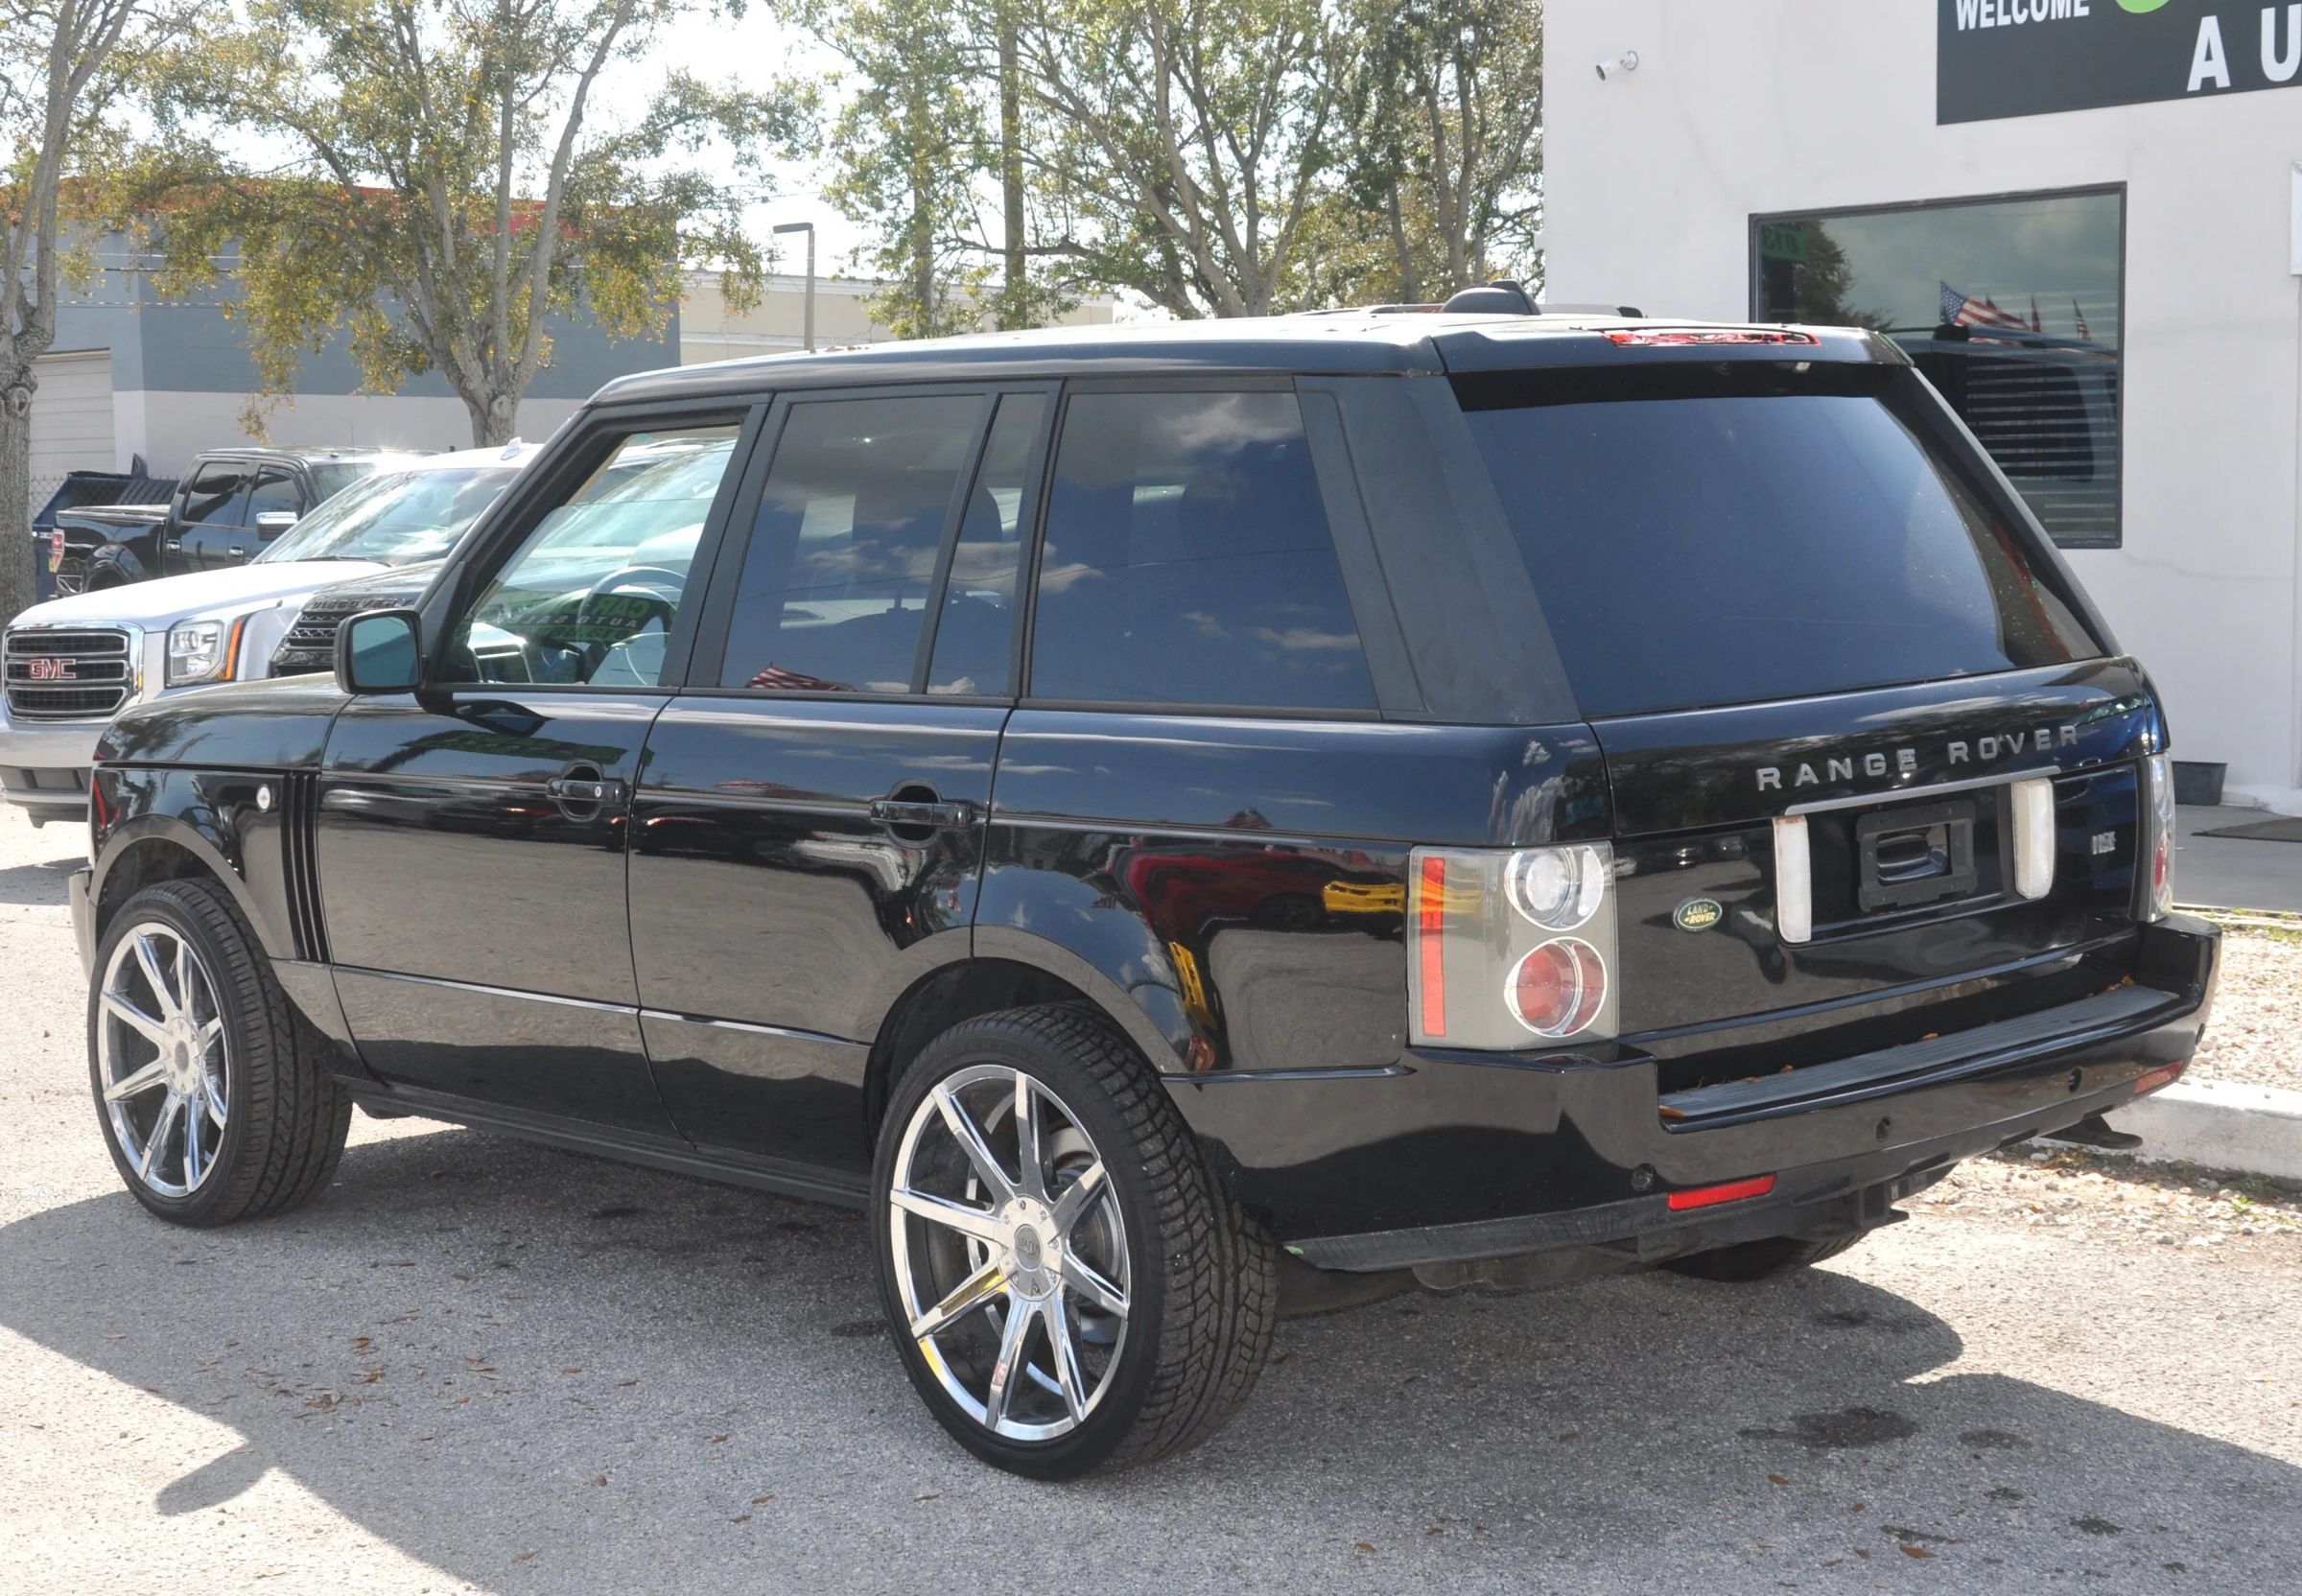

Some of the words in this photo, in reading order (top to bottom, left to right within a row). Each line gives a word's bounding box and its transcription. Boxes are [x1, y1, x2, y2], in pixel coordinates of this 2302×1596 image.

[29, 659, 77, 679] GMC
[1756, 748, 1917, 791] RANGE
[1948, 725, 2078, 764] ROVER
[1687, 904, 1709, 916] LAND
[1688, 912, 1716, 925] ROVER
